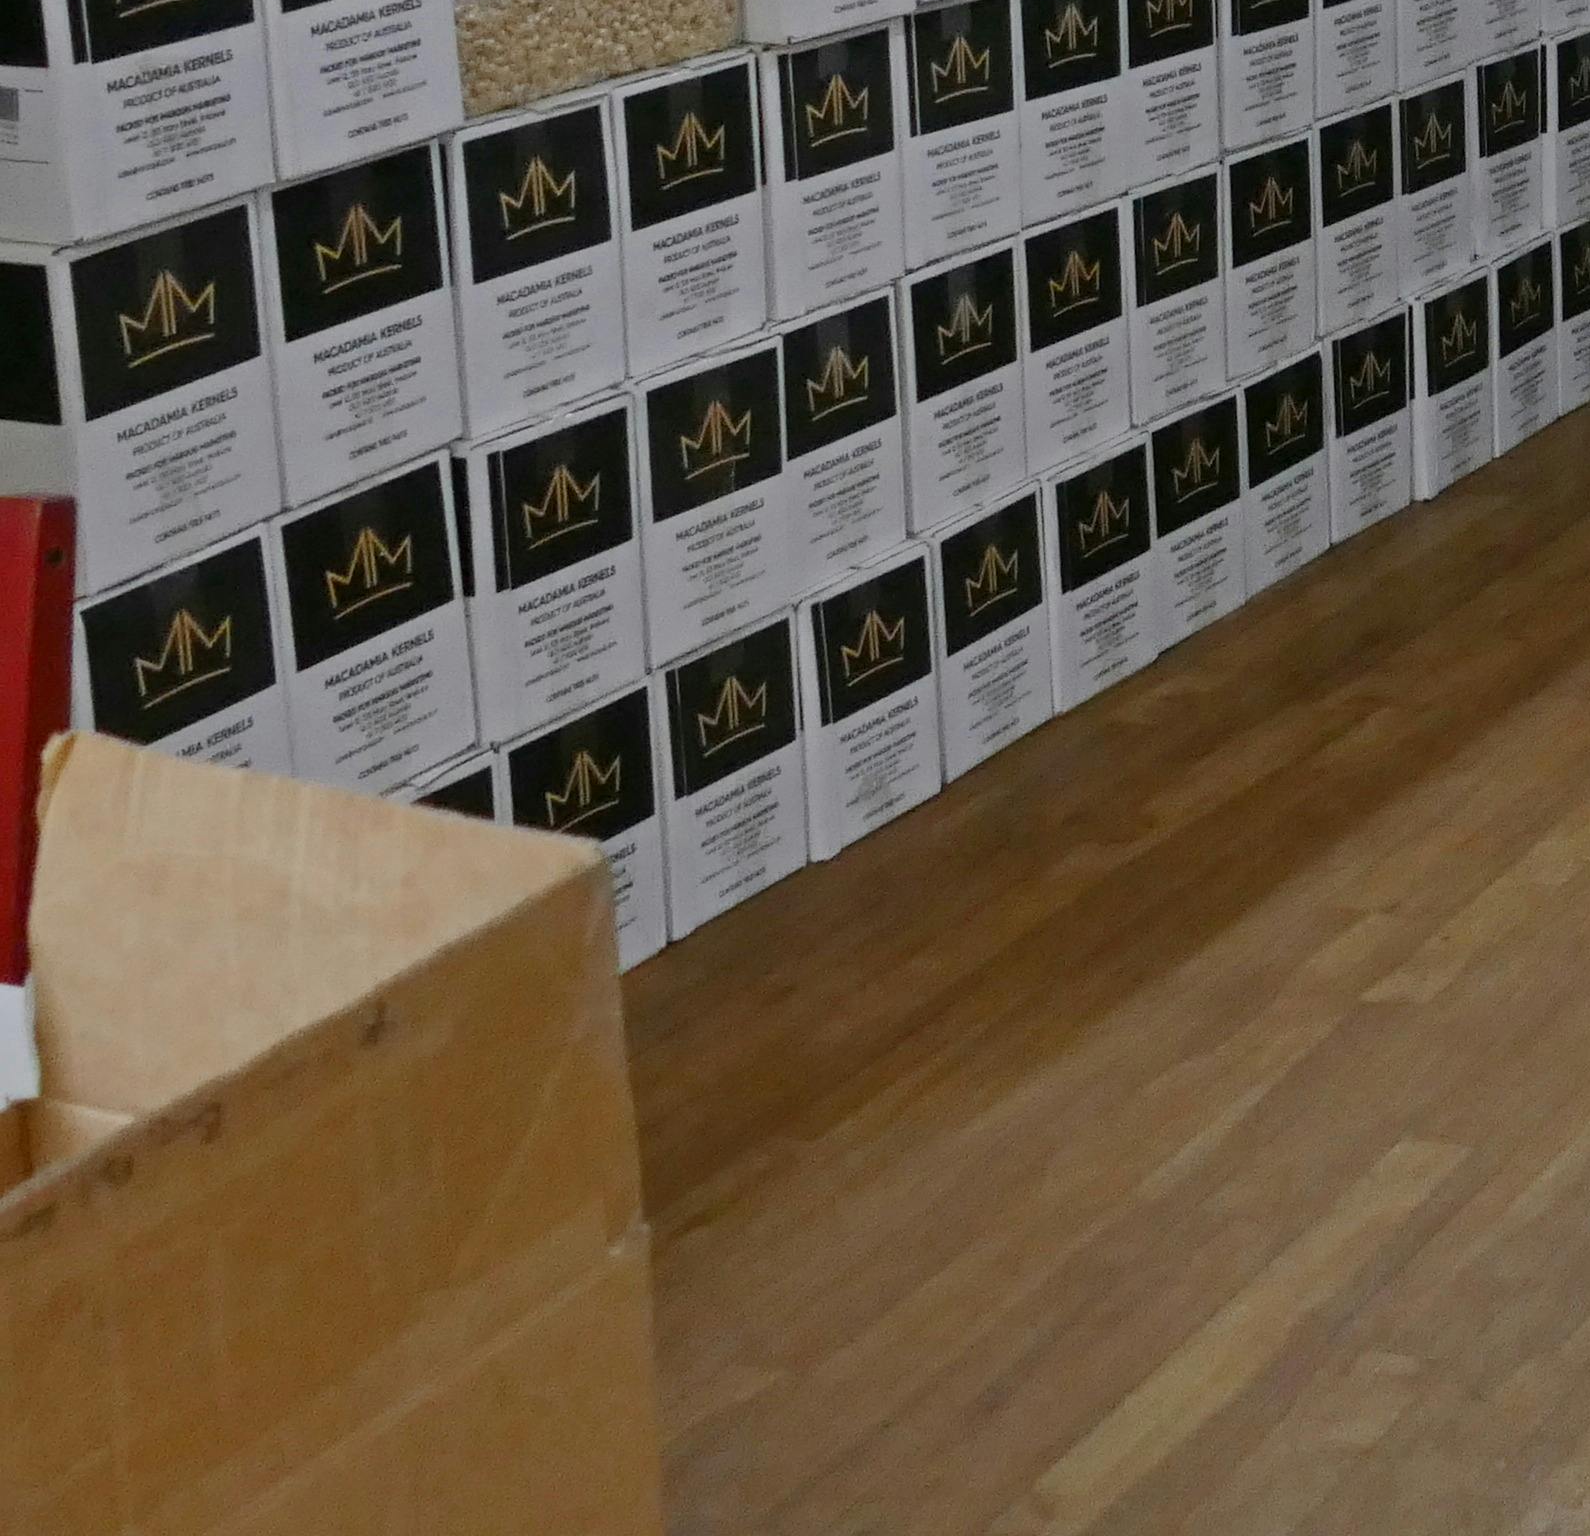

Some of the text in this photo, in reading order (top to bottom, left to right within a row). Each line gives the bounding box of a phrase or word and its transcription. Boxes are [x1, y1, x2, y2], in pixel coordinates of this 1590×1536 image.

[311, 10, 377, 37] MACADAMIA
[117, 385, 240, 444] MACADAMIA KERNELS
[324, 628, 435, 689] MACADAMIA KERNELS
